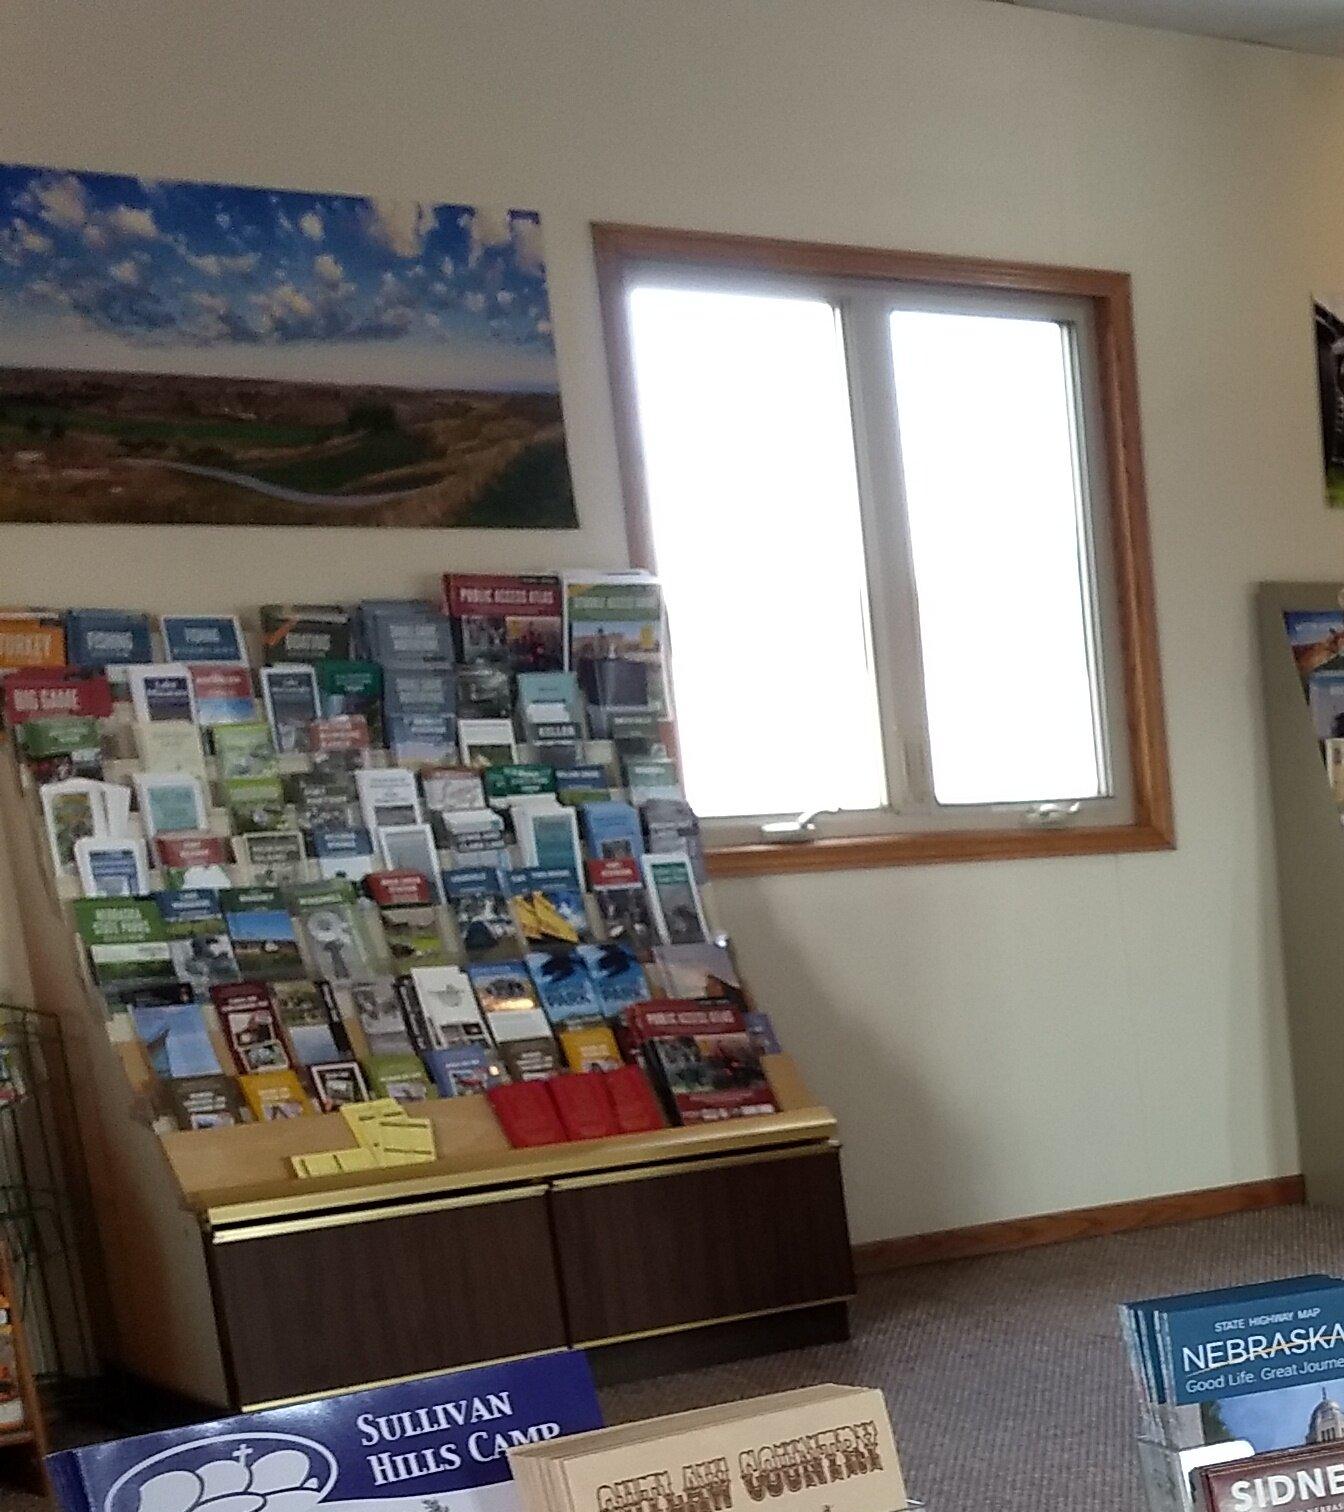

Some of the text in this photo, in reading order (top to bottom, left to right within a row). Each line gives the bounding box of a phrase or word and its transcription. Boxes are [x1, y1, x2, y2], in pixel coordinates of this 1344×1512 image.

[1215, 1308, 1321, 1332] STATE HIGHWAY MAP
[1186, 1375, 1225, 1394] Good
[1229, 1371, 1257, 1386] Life.
[1261, 1366, 1298, 1381] Great
[356, 1391, 513, 1446] SULLIVAN
[366, 1443, 461, 1486] HILLS
[739, 1420, 883, 1501] COUNTRY
